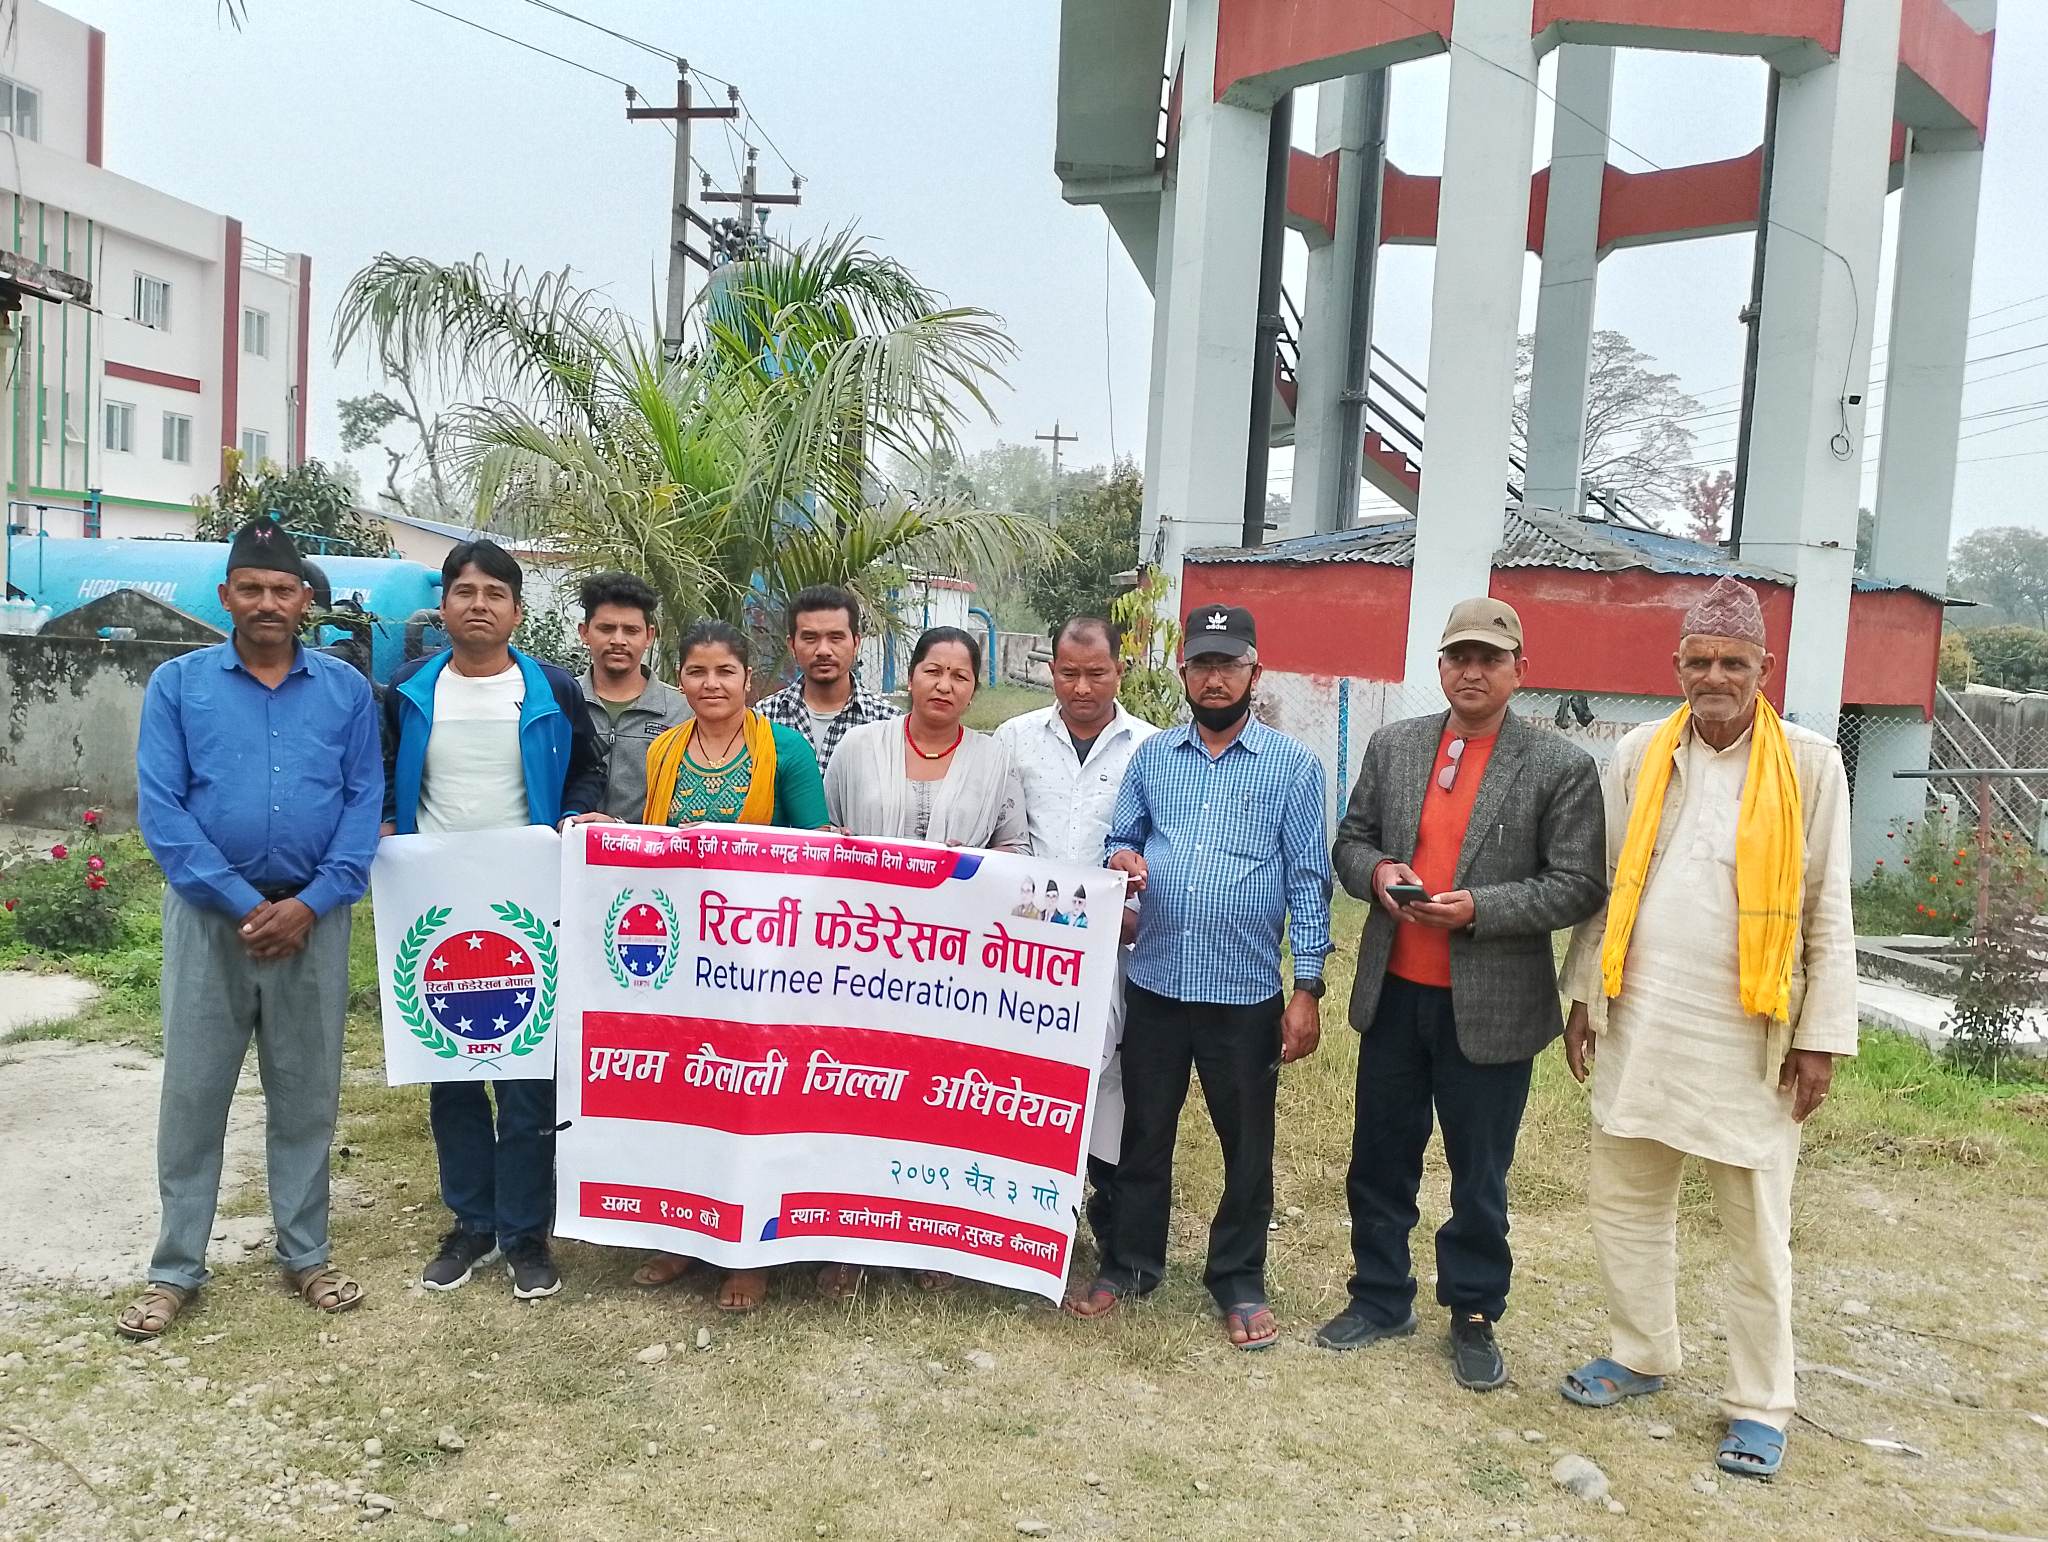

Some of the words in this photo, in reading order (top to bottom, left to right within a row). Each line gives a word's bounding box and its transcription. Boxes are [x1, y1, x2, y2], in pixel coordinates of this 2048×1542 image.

[801, 842, 830, 862] नेपाल
[833, 844, 878, 868] निर्माणको
[906, 857, 937, 875] आधार
[698, 889, 803, 949] रिटर्नी
[815, 900, 971, 966] फेडेरेसन
[981, 922, 1086, 988] नेपाल
[505, 976, 533, 988] नेपाल
[695, 956, 823, 994] Returnee
[833, 965, 988, 1016] Federation
[998, 989, 1081, 1035] Nepal
[467, 1043, 502, 1055] RFN
[587, 1046, 670, 1084] प्रथम
[684, 1042, 789, 1096] कैलाली
[801, 1048, 910, 1102] जिल्ला
[922, 1068, 1083, 1135] अधिवेशन
[600, 1195, 642, 1213] समय
[699, 1207, 721, 1229] बजे
[891, 1160, 951, 1191] २०७९
[964, 1162, 995, 1200] चैत्र
[1007, 1180, 1018, 1205] ३
[1032, 1179, 1060, 1215] गते
[838, 1206, 902, 1230] खानेपानी
[1010, 1232, 1059, 1263] कैलाली
